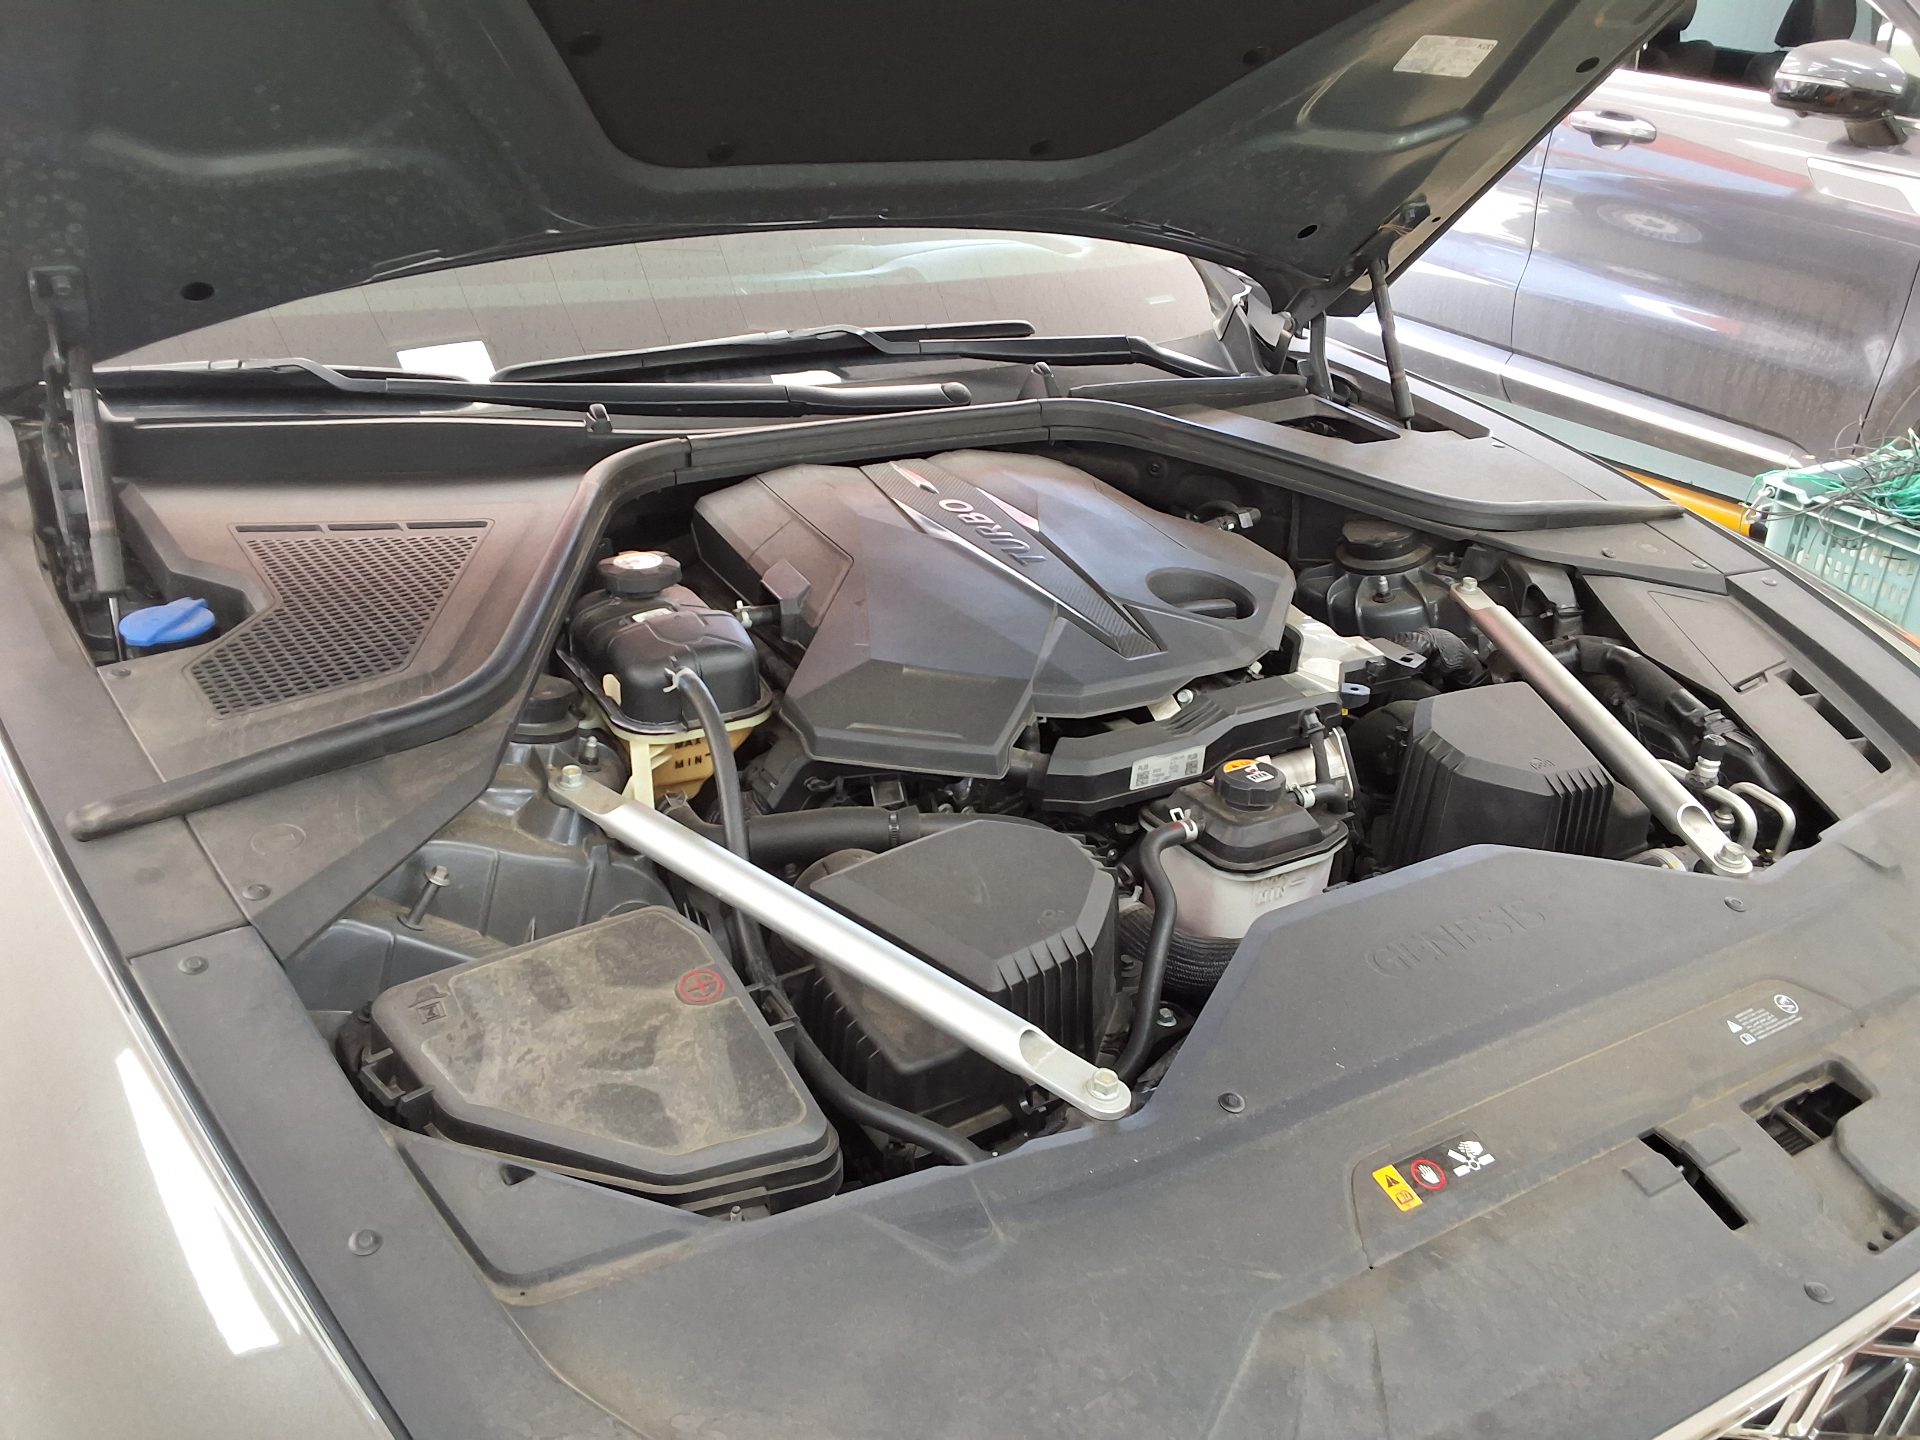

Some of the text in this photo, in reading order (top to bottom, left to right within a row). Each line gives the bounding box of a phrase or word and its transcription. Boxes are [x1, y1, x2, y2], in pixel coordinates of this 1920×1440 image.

[938, 498, 1047, 566] TURBO
[674, 755, 702, 769] MIN
[1365, 898, 1547, 979] GENESIS
